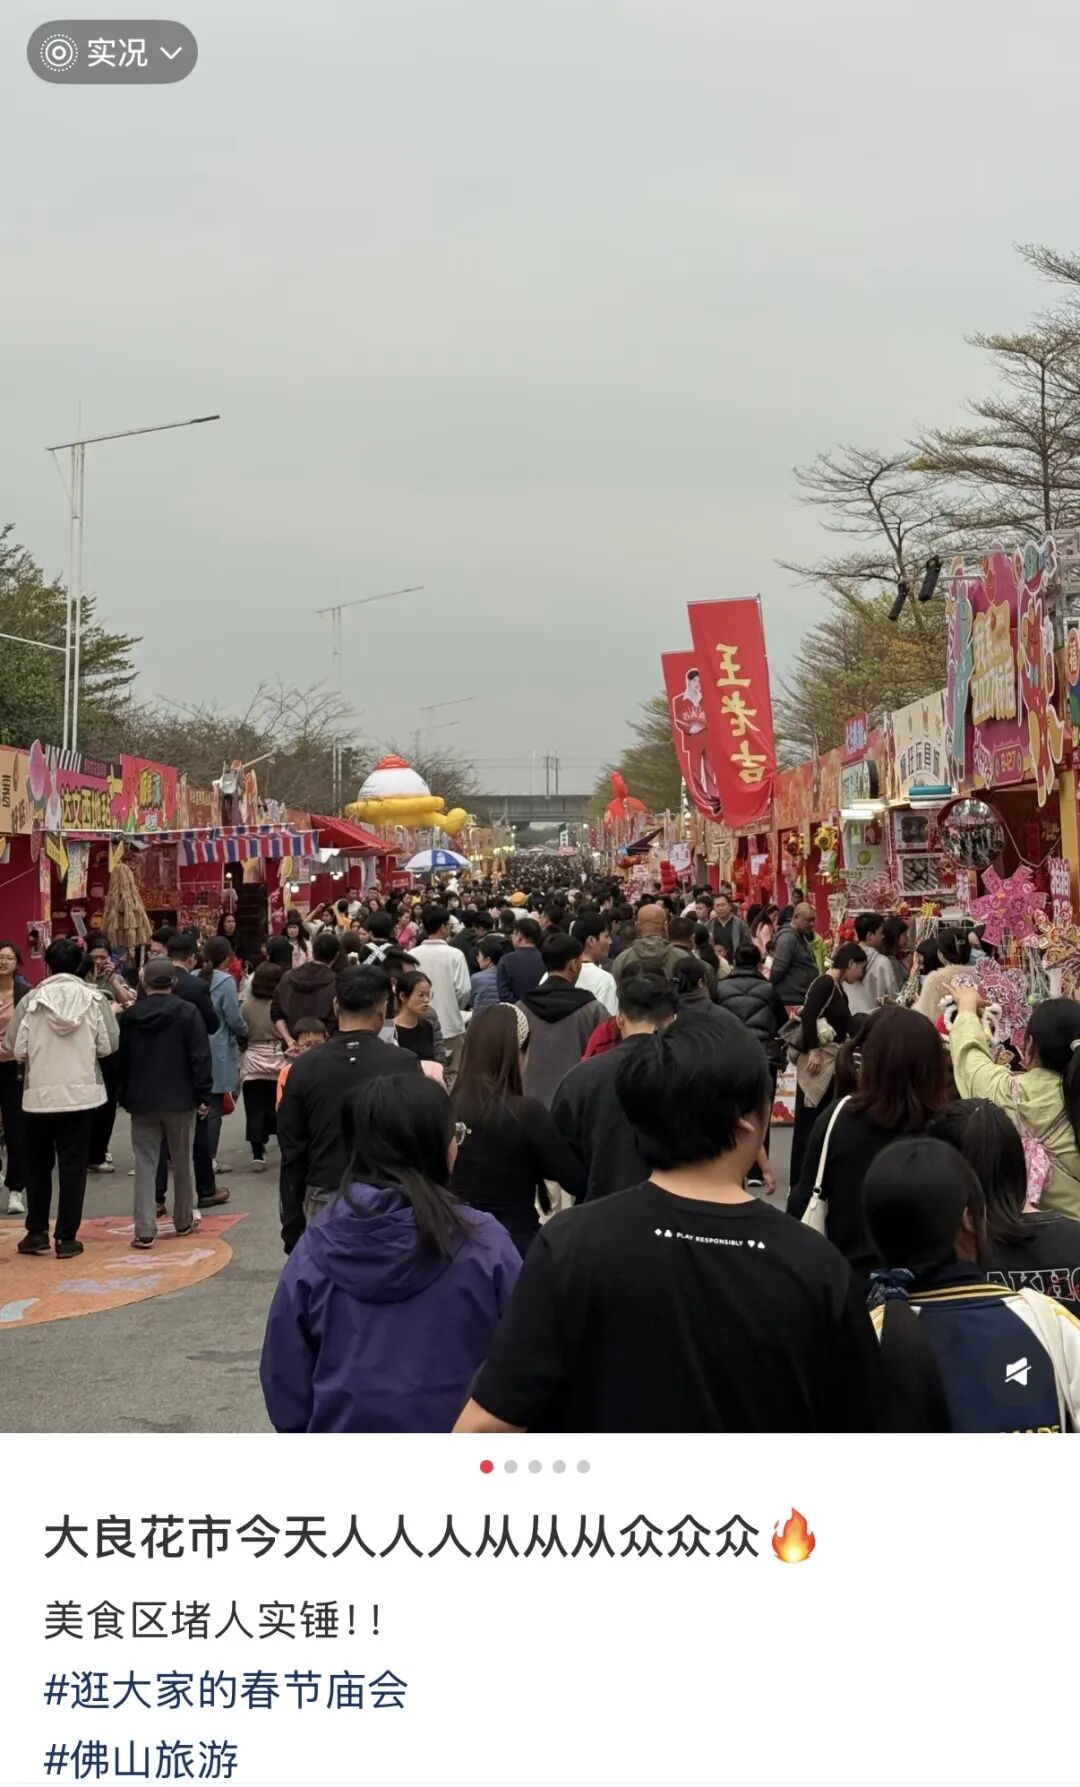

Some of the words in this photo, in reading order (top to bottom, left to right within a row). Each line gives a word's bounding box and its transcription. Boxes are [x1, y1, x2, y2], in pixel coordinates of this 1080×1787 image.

[716, 643, 767, 784] 王老吉
[676, 1232, 694, 1241] PLAY
[695, 1236, 744, 1246] RESPONSIBLY
